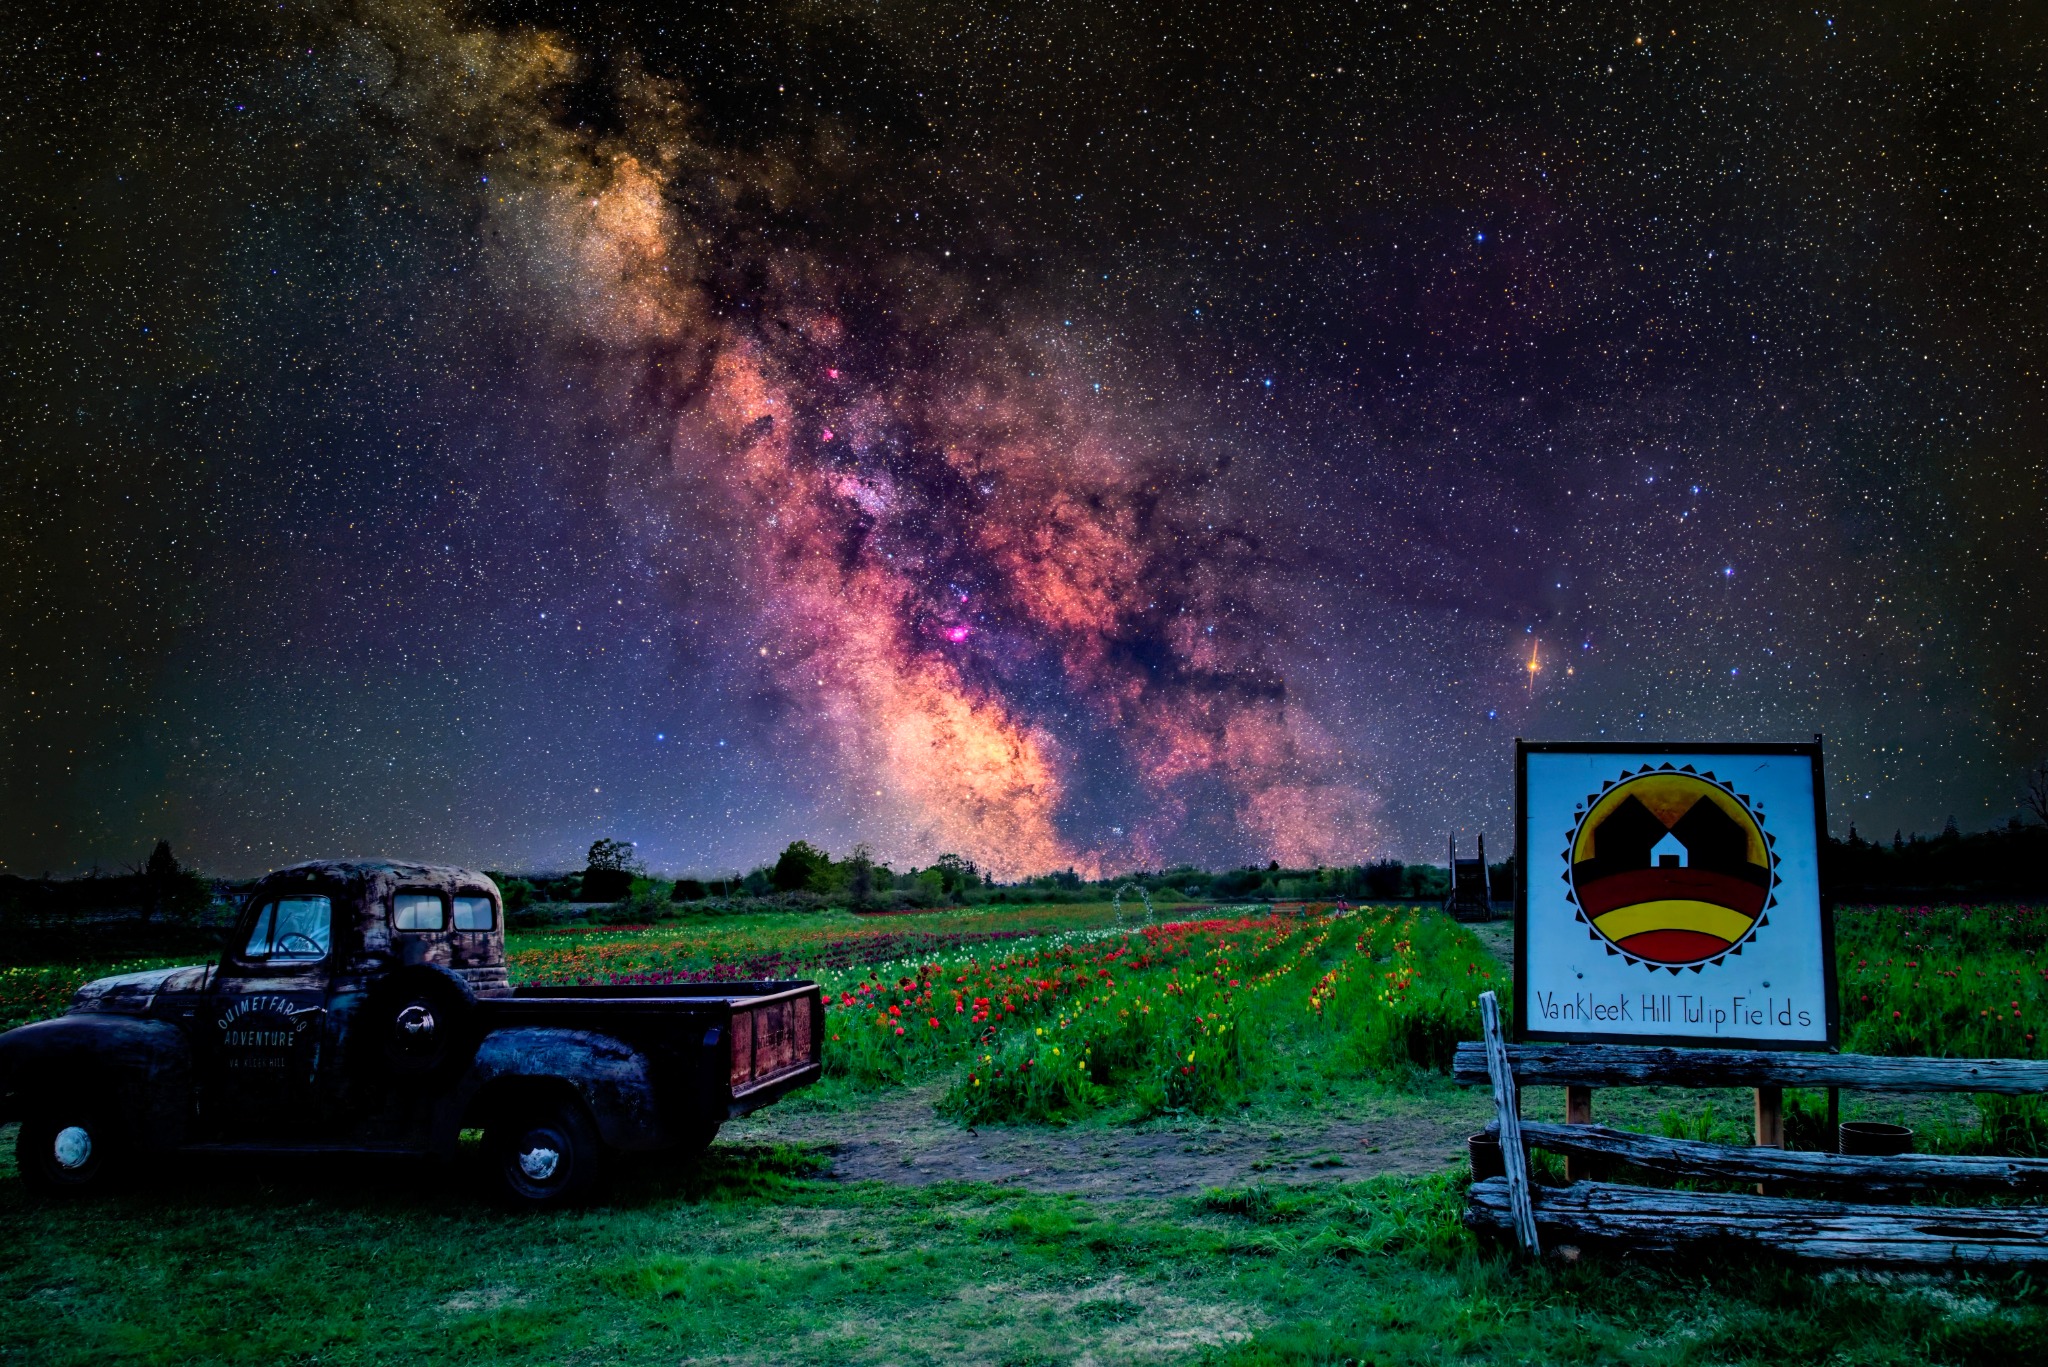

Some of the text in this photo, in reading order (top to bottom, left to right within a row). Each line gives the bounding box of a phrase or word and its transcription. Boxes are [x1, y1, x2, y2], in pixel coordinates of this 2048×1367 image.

[217, 996, 267, 1030] OUIMET
[1642, 994, 1671, 1023] Hill
[1677, 995, 1726, 1034] Tulip
[1733, 996, 1812, 1027] Fields
[224, 1031, 295, 1047] ADVENTURE
[270, 1057, 285, 1068] HILL
